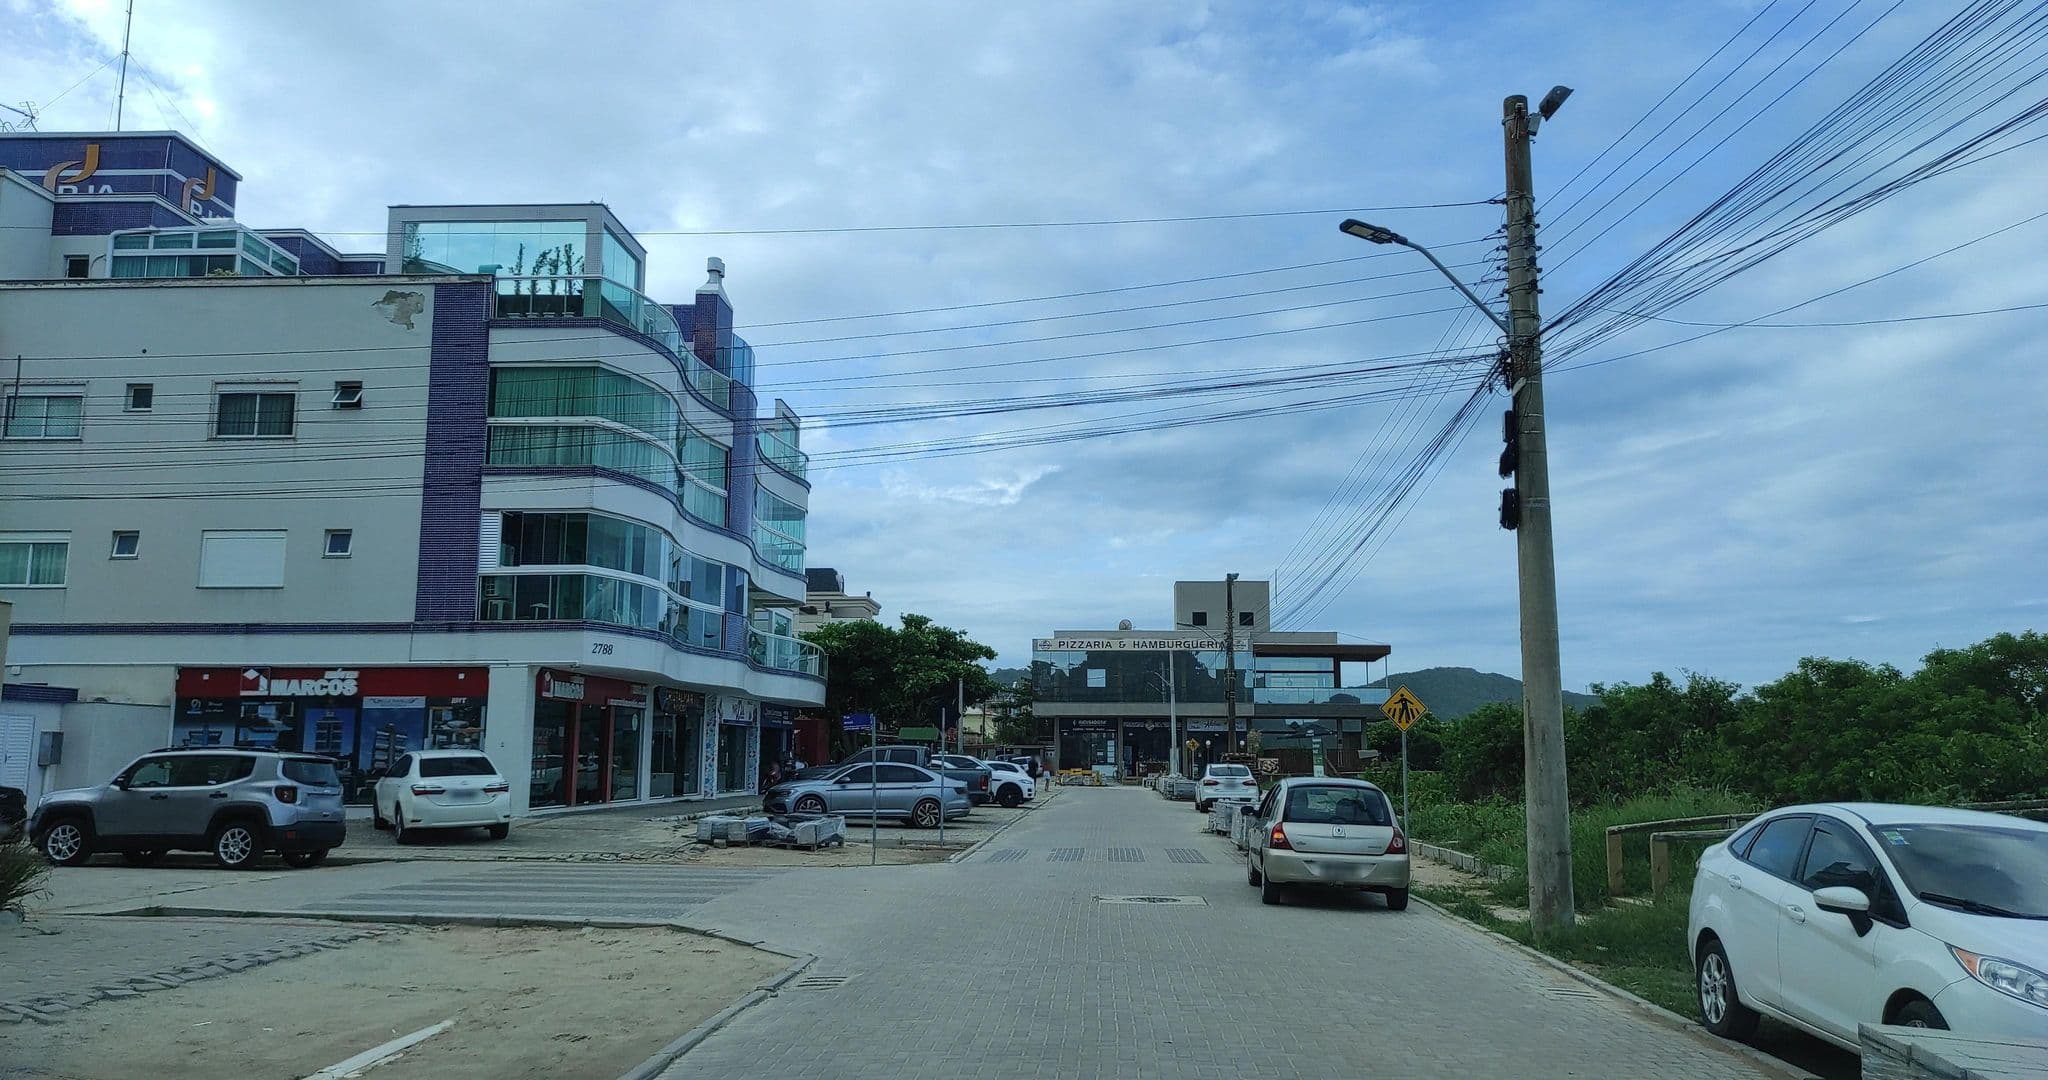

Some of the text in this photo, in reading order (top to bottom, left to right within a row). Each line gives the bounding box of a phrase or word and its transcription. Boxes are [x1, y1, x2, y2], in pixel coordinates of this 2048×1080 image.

[592, 642, 614, 656] 2788
[1058, 640, 1113, 649] PIZZARIA
[1118, 640, 1127, 649] &
[270, 679, 358, 696] MARCOS
